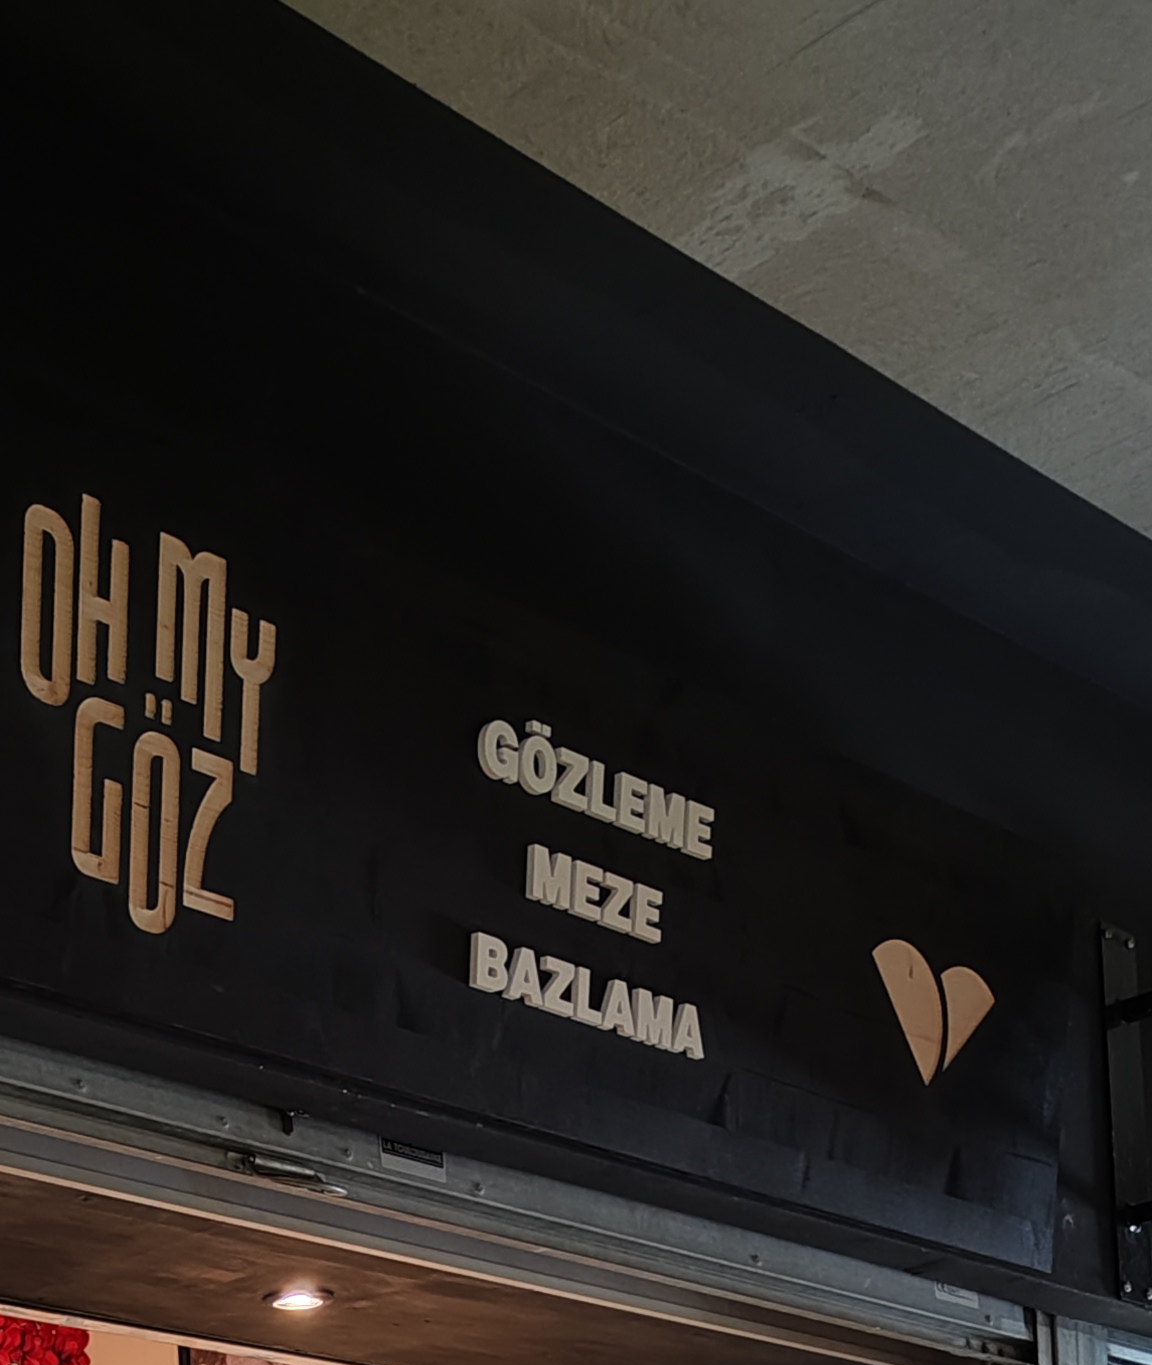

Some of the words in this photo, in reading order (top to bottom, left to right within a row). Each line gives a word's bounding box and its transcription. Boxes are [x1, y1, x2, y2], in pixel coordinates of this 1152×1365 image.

[21, 493, 130, 706] OH
[155, 531, 277, 775] MY
[71, 692, 235, 934] GÖZ
[478, 720, 715, 860] GÖZLEME
[526, 844, 663, 943] MEZE
[469, 932, 705, 1060] BAZLAMA
